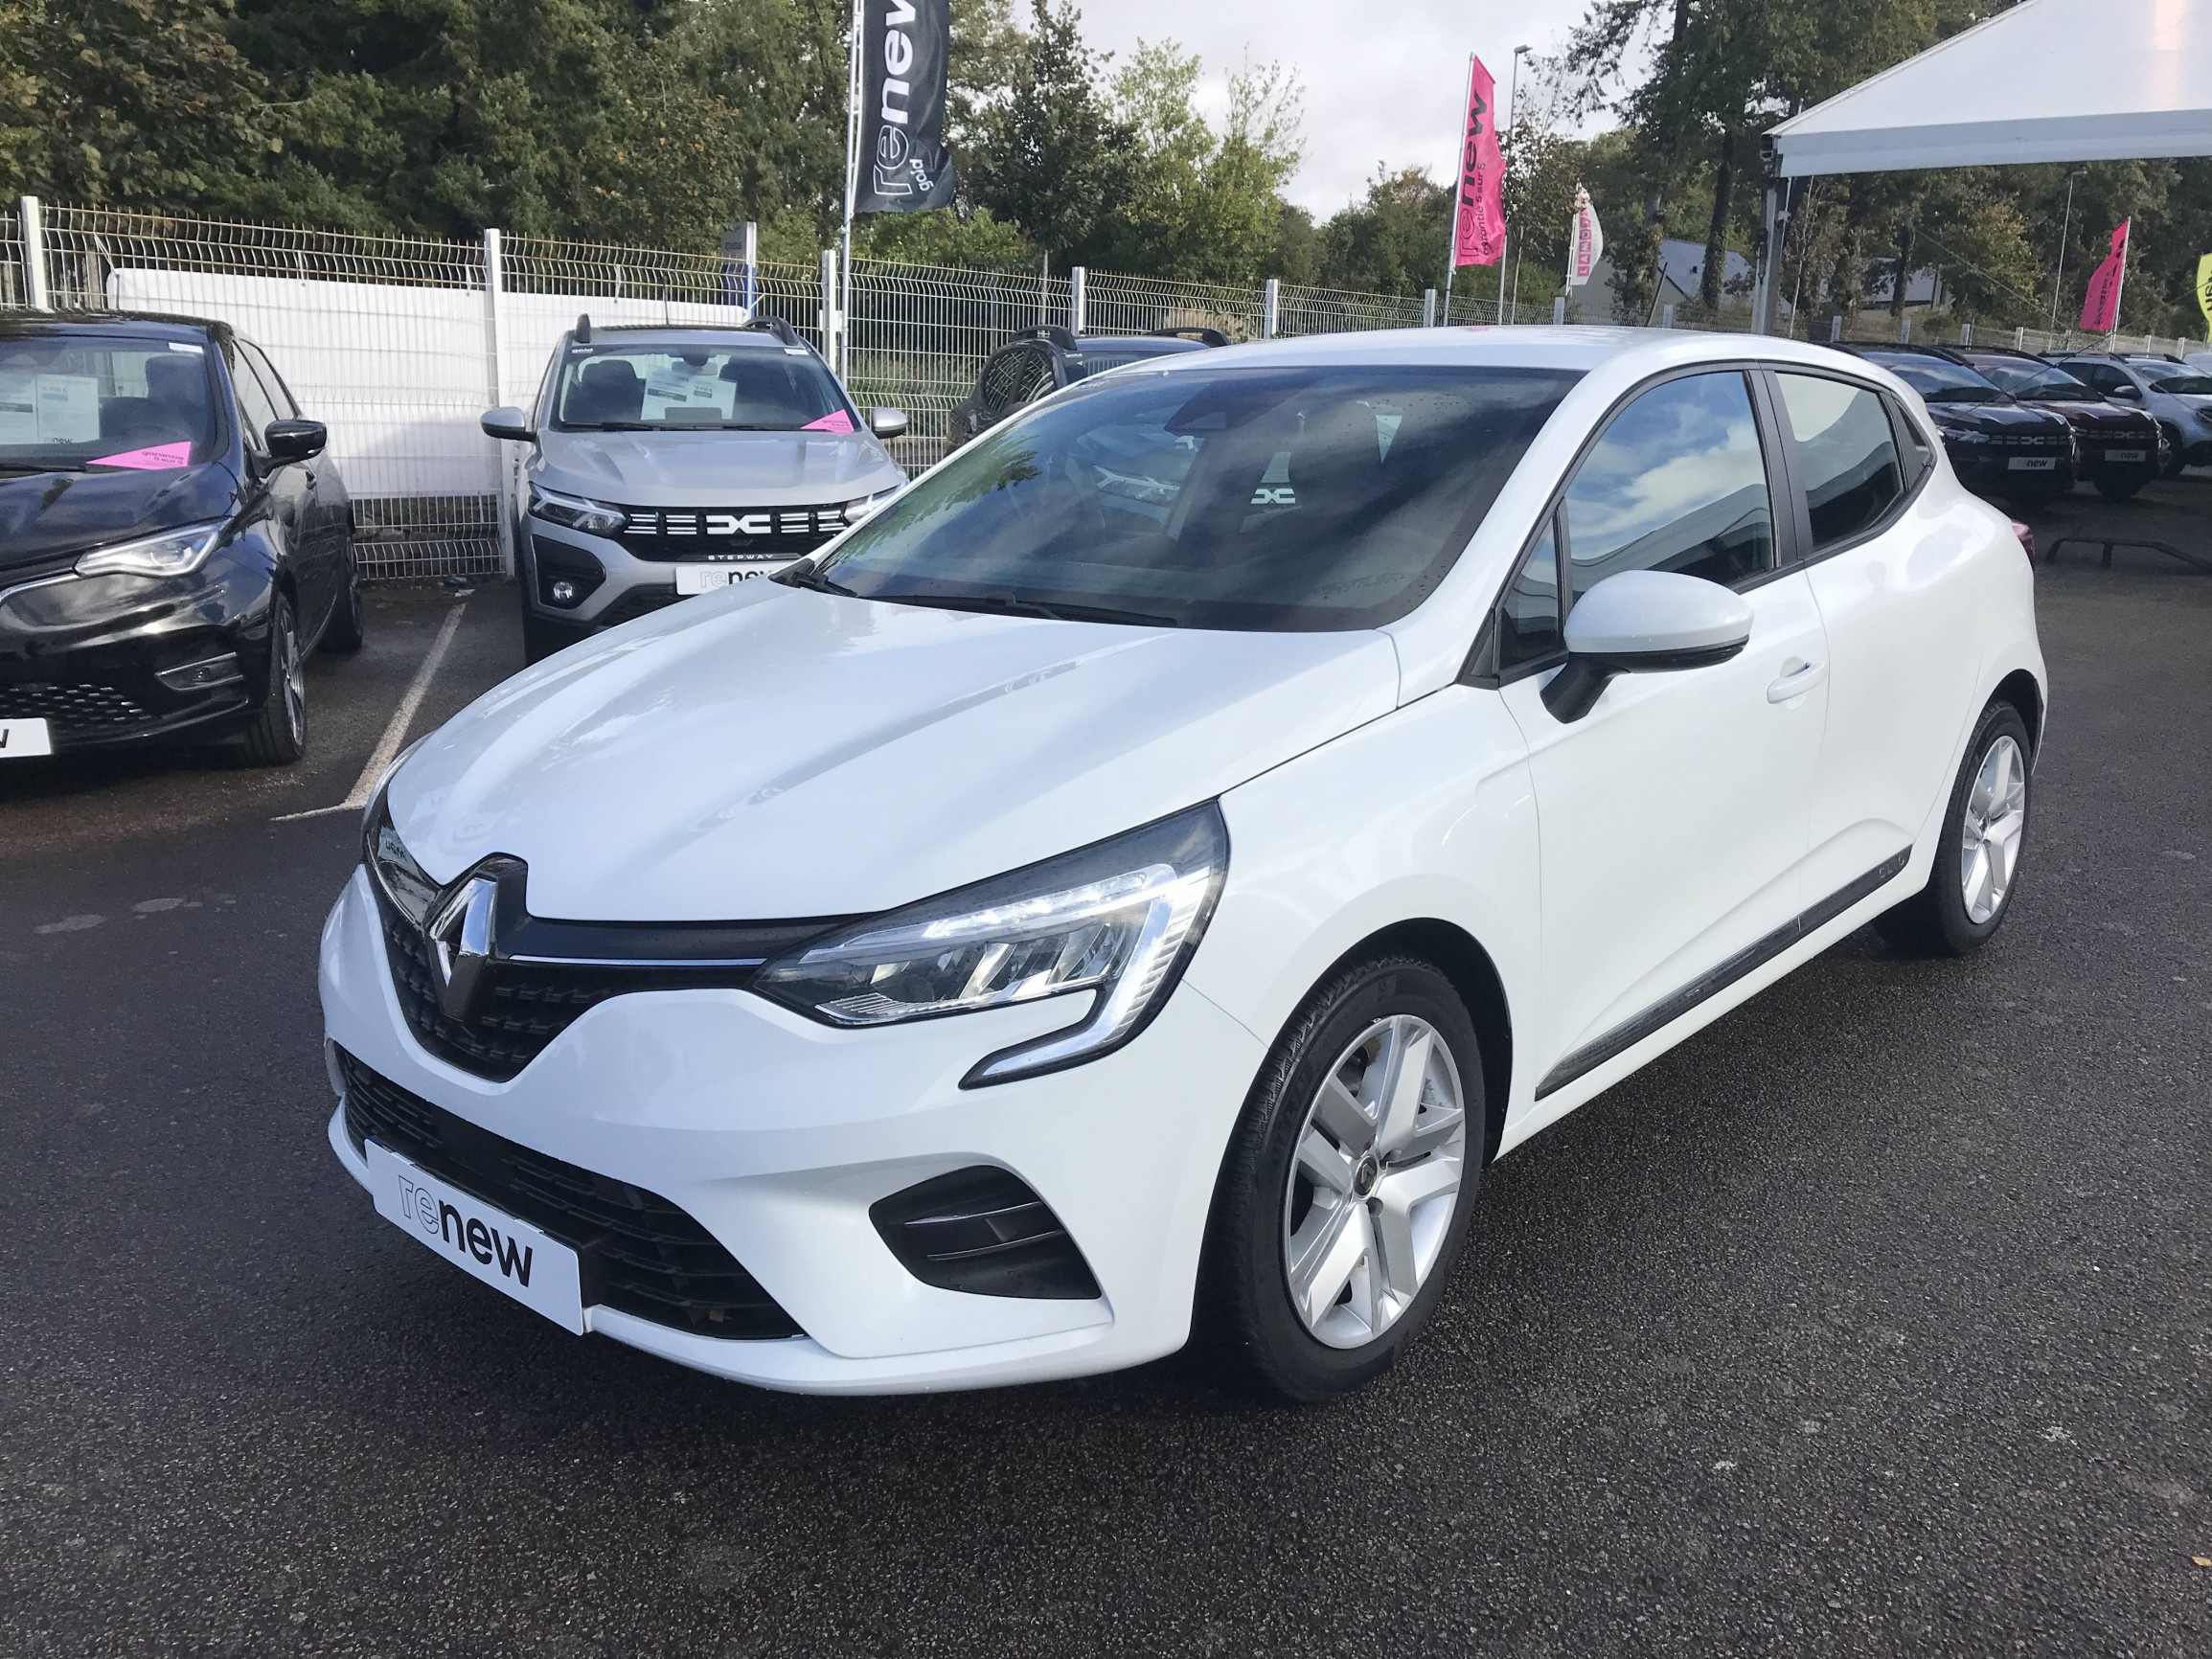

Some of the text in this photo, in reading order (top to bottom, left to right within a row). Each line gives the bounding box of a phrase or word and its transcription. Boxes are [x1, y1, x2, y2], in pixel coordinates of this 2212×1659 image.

[909, 158, 934, 192] gold
[1460, 89, 1488, 258] renew
[1476, 194, 1483, 203] 5
[398, 1174, 534, 1288] renew
